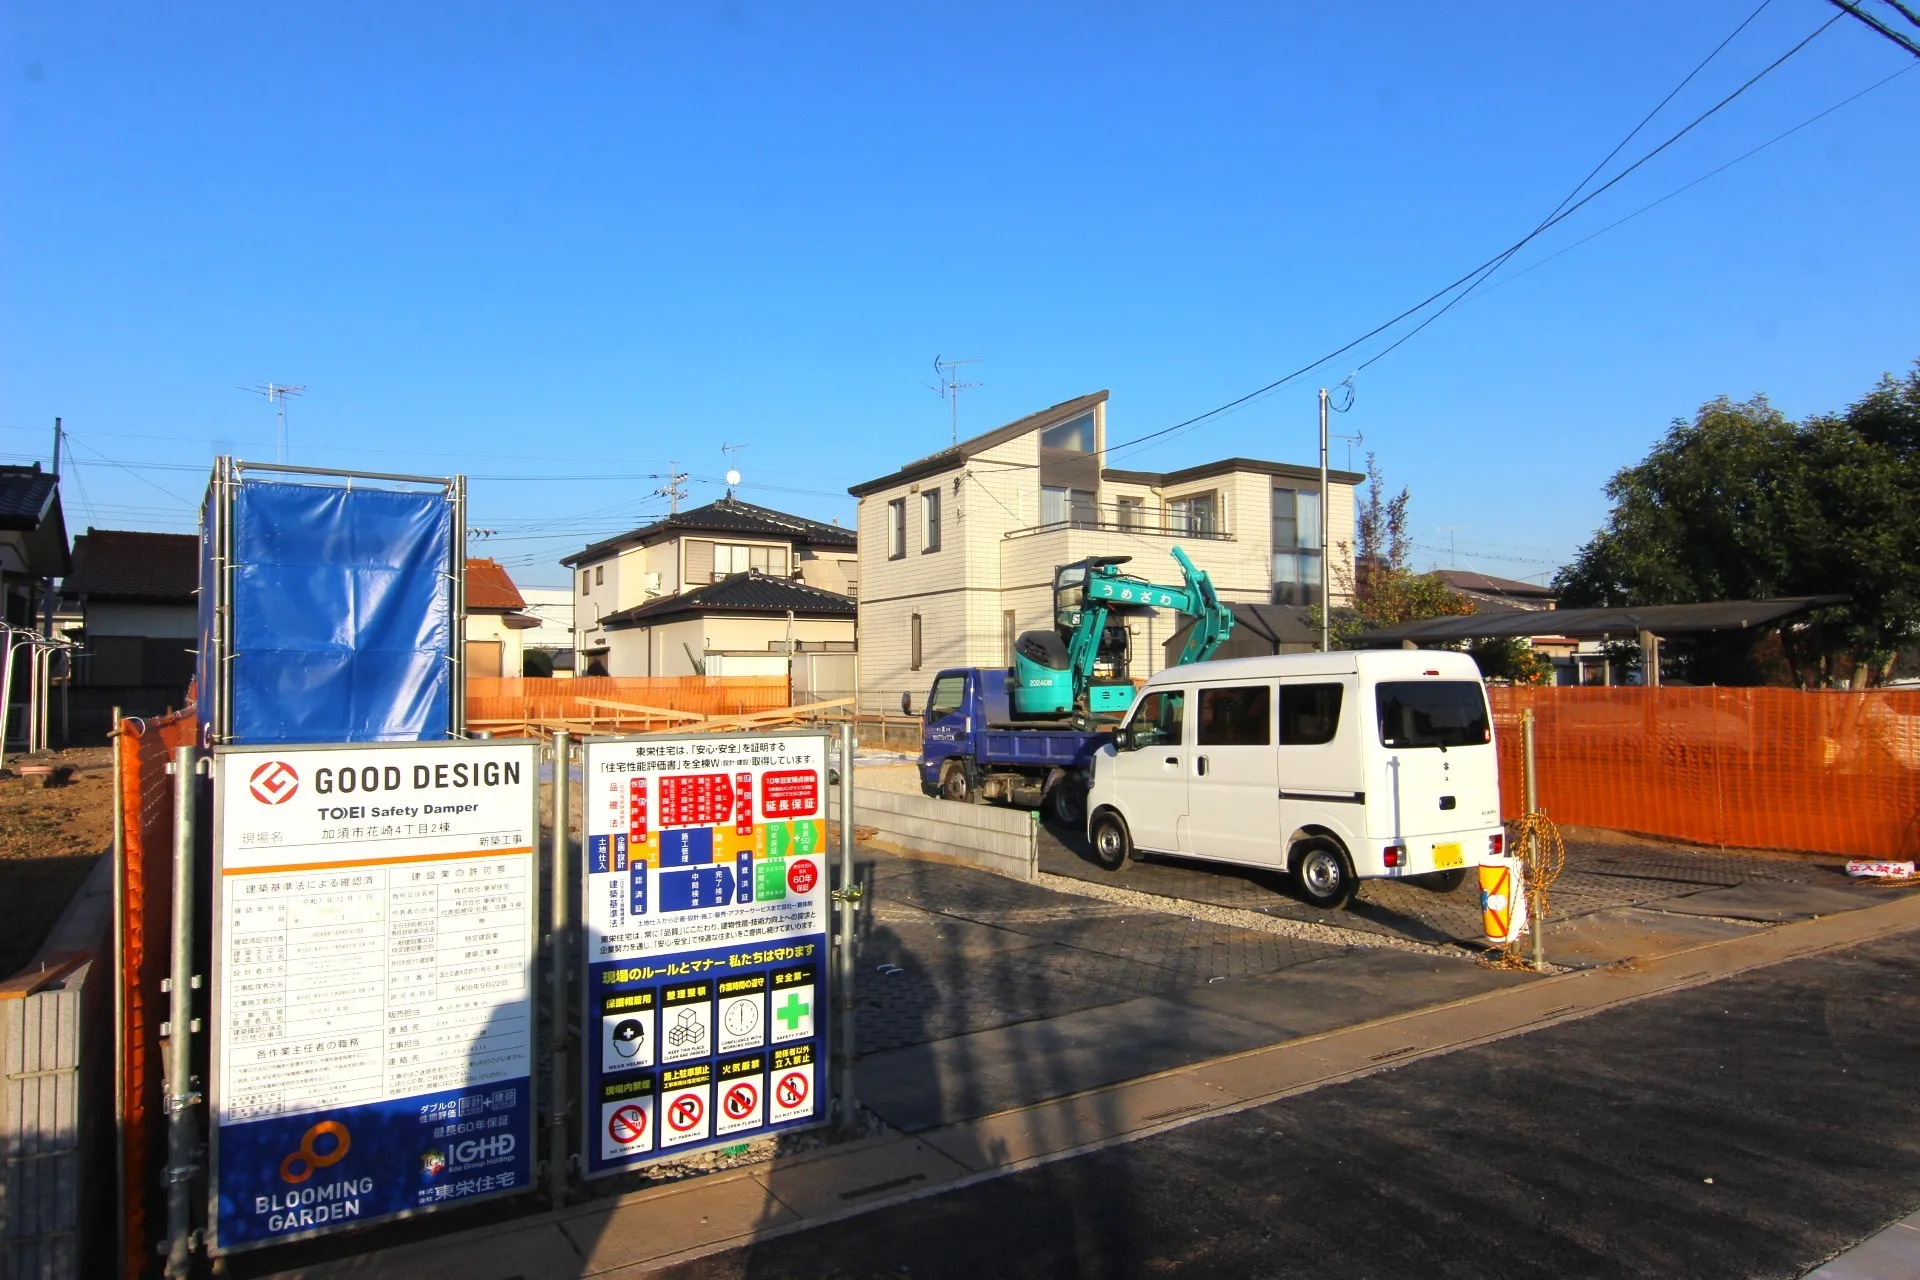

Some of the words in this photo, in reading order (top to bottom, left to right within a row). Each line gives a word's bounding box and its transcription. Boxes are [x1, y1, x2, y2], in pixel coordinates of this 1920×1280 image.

[1103, 584, 1171, 606] うめざわ
[315, 766, 401, 794] GOOD
[413, 761, 520, 789] DESIGN
[371, 805, 419, 818] Safety
[424, 802, 479, 816] Damper
[766, 798, 814, 812] 延長保証
[242, 831, 282, 845] 現場名
[322, 822, 451, 841] 加須市花崎4丁目2棟
[479, 835, 522, 847] 新築工事
[770, 825, 779, 855] 10年保証
[599, 838, 607, 870] 土地仕入
[681, 833, 689, 863] 施工管理
[635, 862, 643, 913] 確認済証
[691, 873, 699, 906] 中間検査
[793, 874, 812, 884] 60年
[609, 880, 618, 928] 建築基準法
[602, 959, 726, 984] 現場のルールとマナー
[729, 943, 815, 968] 私たちは守ります
[775, 972, 811, 984] 安全第一
[774, 1045, 810, 1059] 関係者以外
[775, 1054, 810, 1068] 立入禁止
[663, 1065, 709, 1082] 路上駐車禁止
[722, 1059, 760, 1075] 火気厳禁
[421, 1101, 456, 1114] ダブルの
[464, 1161, 485, 1170] Group
[487, 1155, 516, 1165] Holdings
[255, 1176, 373, 1215] BLOOMING
[435, 1172, 515, 1200] 東栄住宅
[268, 1199, 360, 1232] GARDEN
